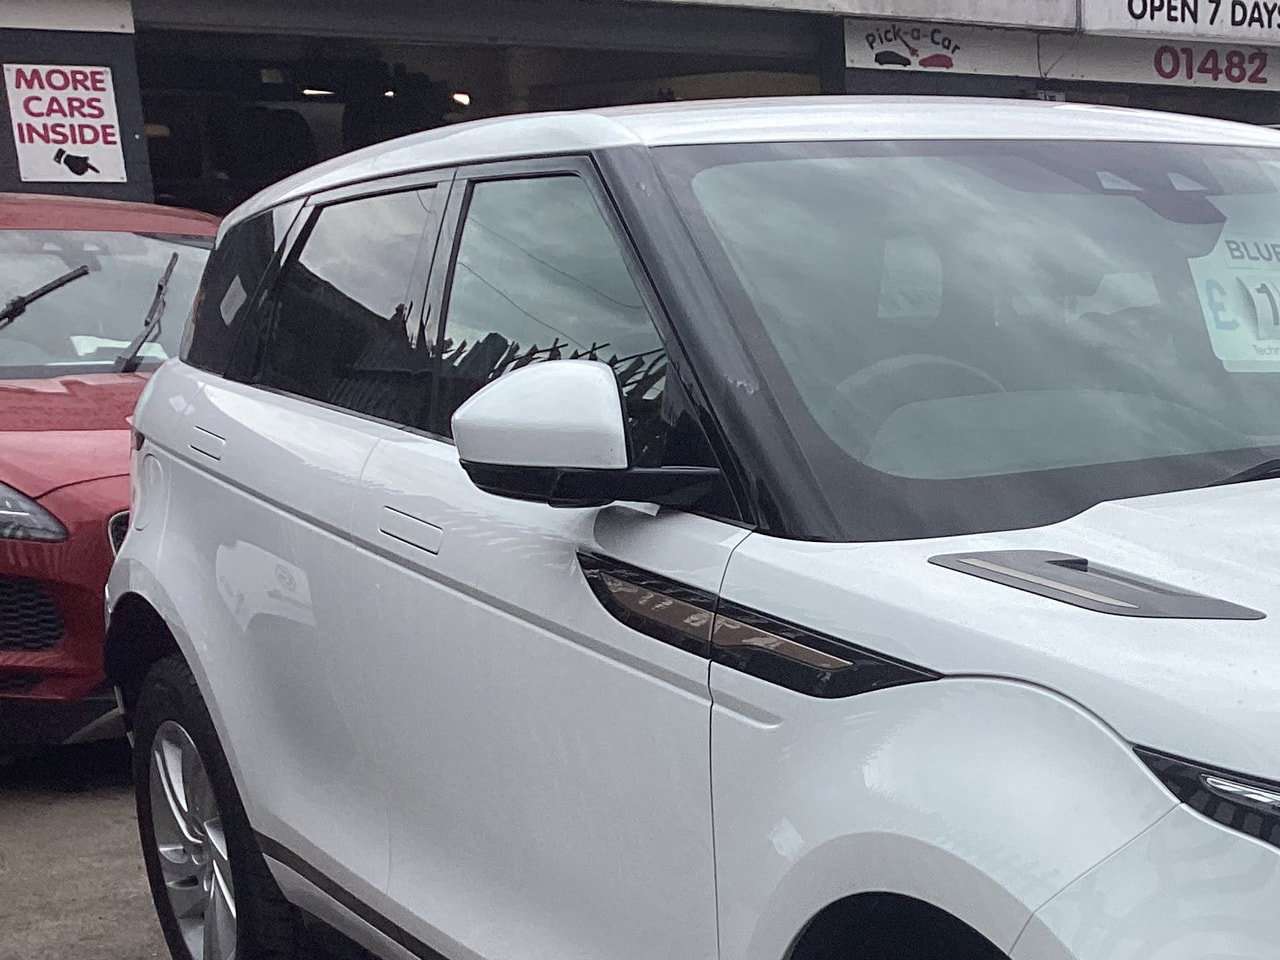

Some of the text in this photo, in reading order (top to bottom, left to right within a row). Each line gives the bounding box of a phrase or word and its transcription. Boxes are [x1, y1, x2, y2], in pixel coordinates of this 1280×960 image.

[1127, 0, 1198, 24] OPEN
[1207, 0, 1221, 25] 7
[865, 24, 960, 54] Pick-a-Car
[1154, 46, 1267, 83] 01482
[15, 68, 106, 92] MORE
[23, 96, 104, 118] CARS
[17, 123, 117, 145] INSIDE
